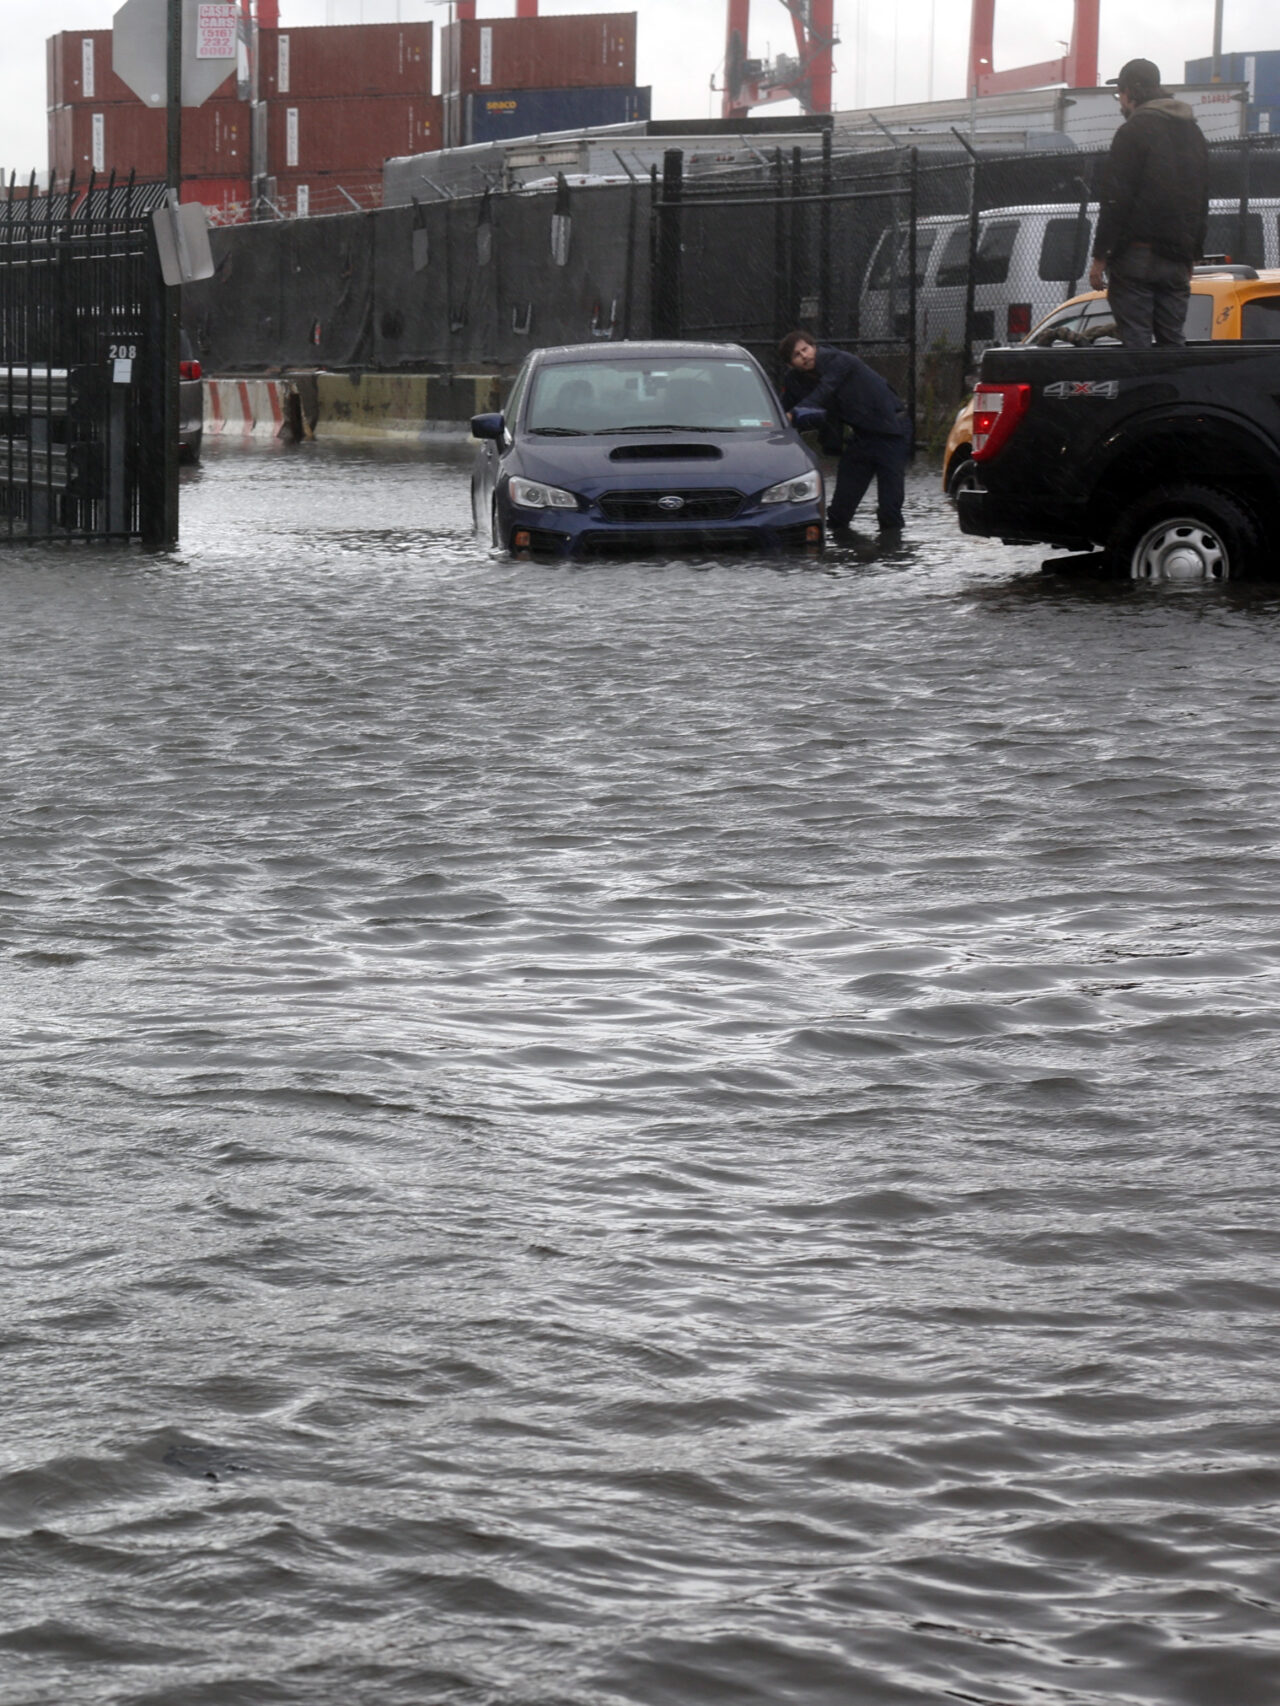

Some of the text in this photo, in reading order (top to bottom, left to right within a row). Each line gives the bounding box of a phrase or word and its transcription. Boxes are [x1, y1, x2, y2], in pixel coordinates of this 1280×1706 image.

[202, 29, 233, 38] (516)
[203, 38, 231, 47] 232
[109, 345, 137, 359] 208
